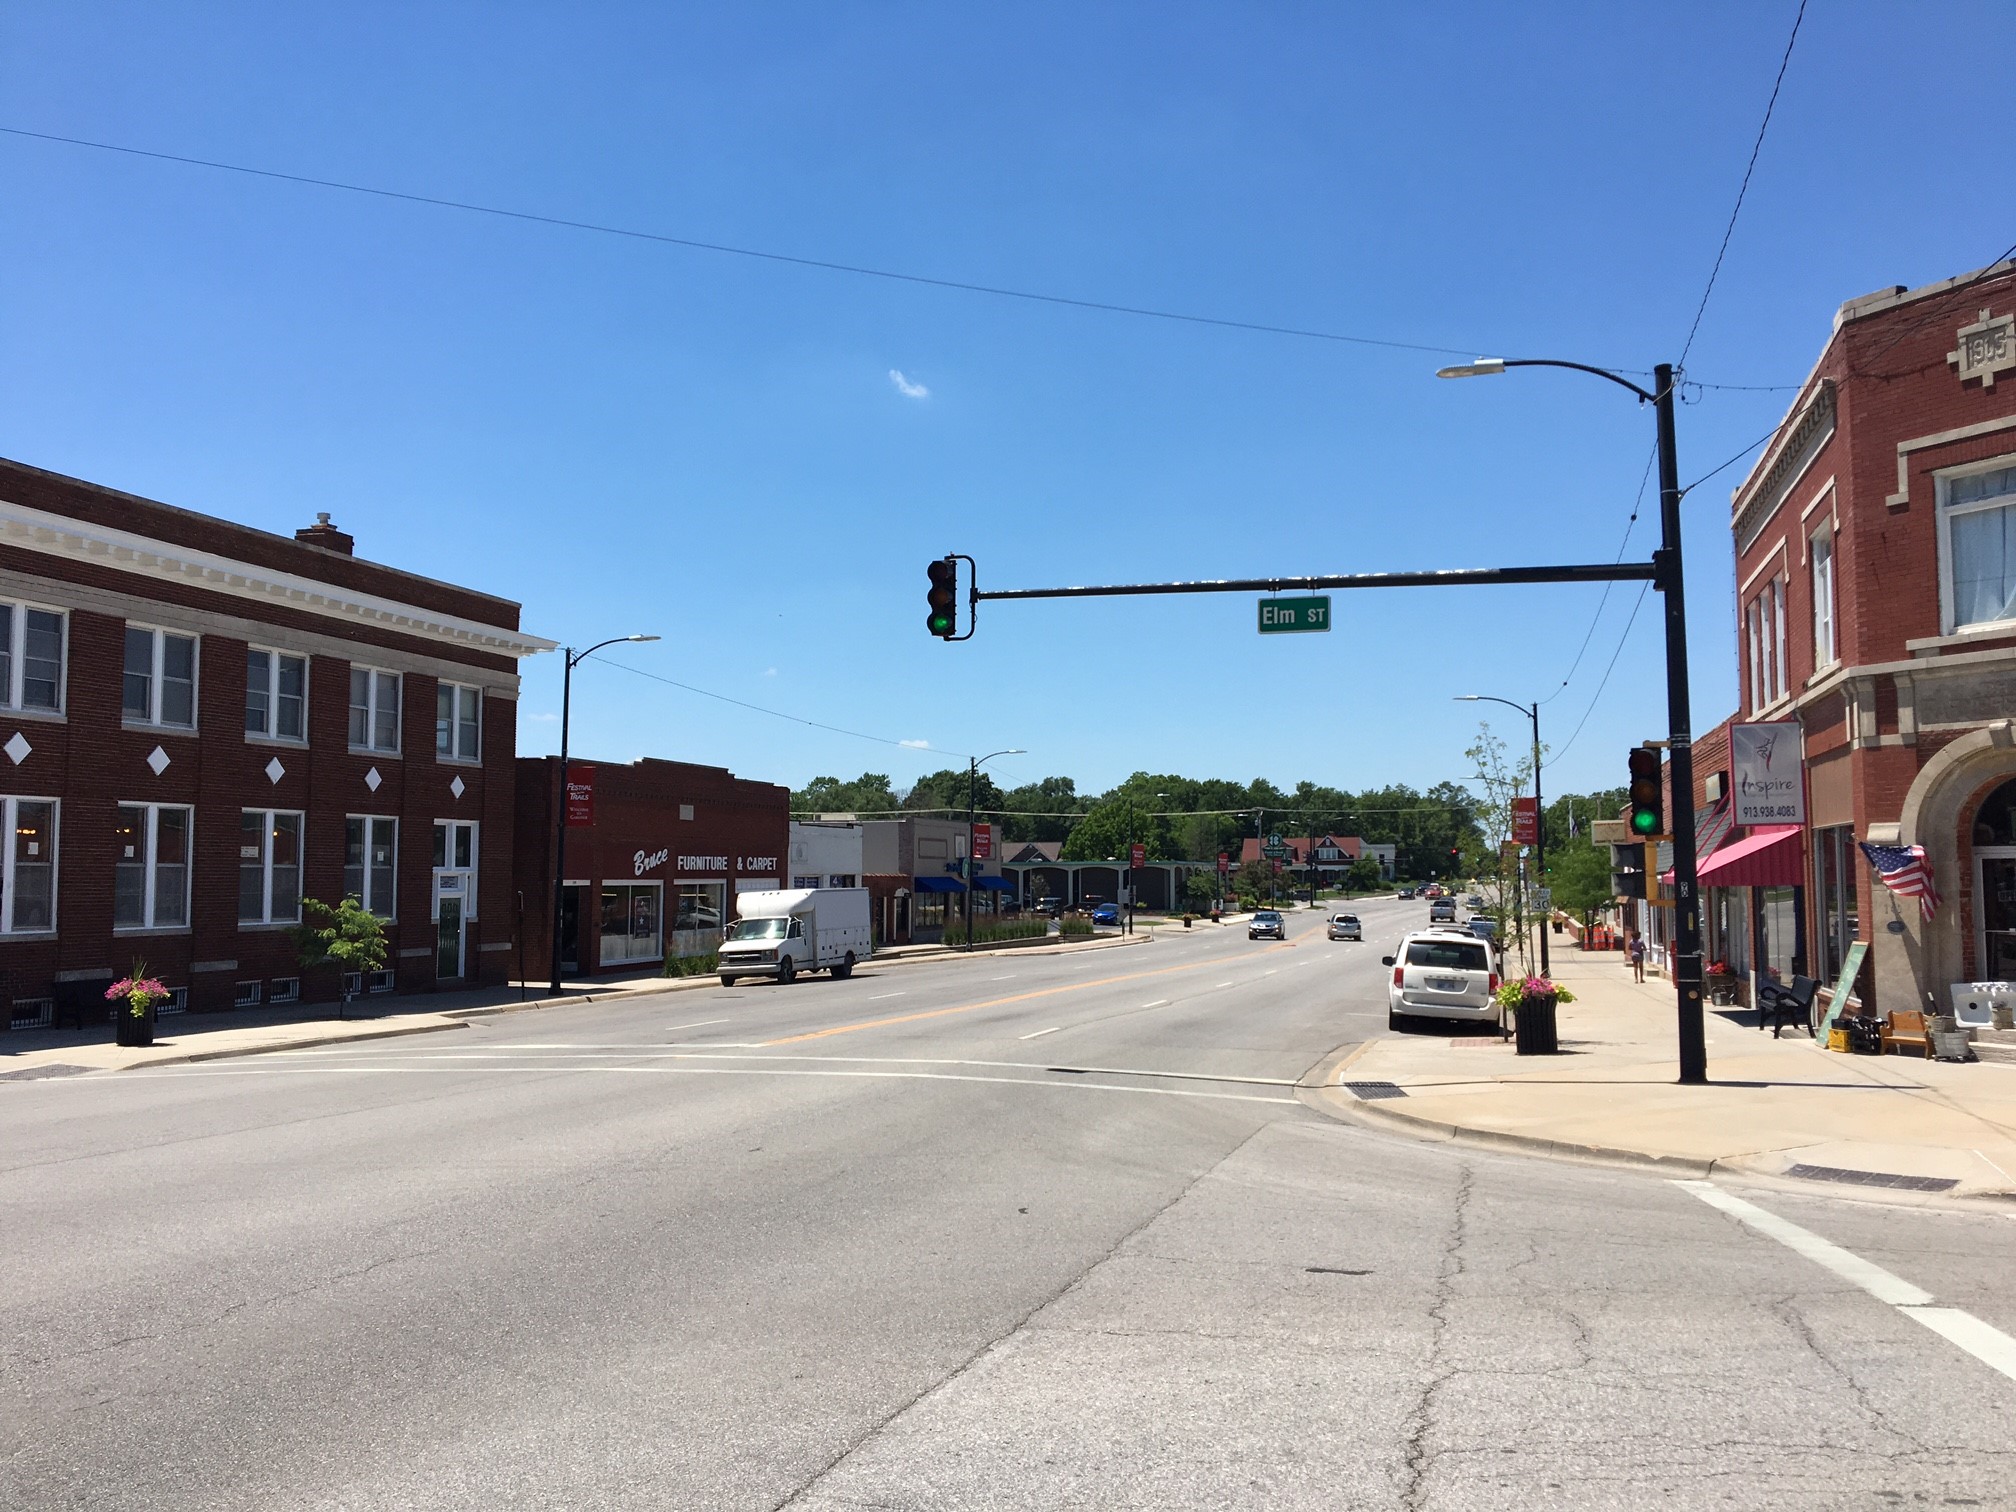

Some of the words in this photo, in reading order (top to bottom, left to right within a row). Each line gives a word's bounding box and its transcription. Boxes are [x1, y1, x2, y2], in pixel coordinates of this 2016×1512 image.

[1969, 332, 2007, 366] 1905
[1263, 606, 1295, 624] Elm
[1307, 608, 1325, 622] ST
[1741, 768, 1794, 799] Inspire
[570, 792, 589, 800] TRAILS
[1743, 805, 1796, 817] 913.938.4083
[633, 848, 669, 876] Bruce
[677, 855, 728, 870] FURNITURE
[737, 856, 743, 870] &
[746, 857, 778, 870] CARPET
[1534, 900, 1550, 909] 30
